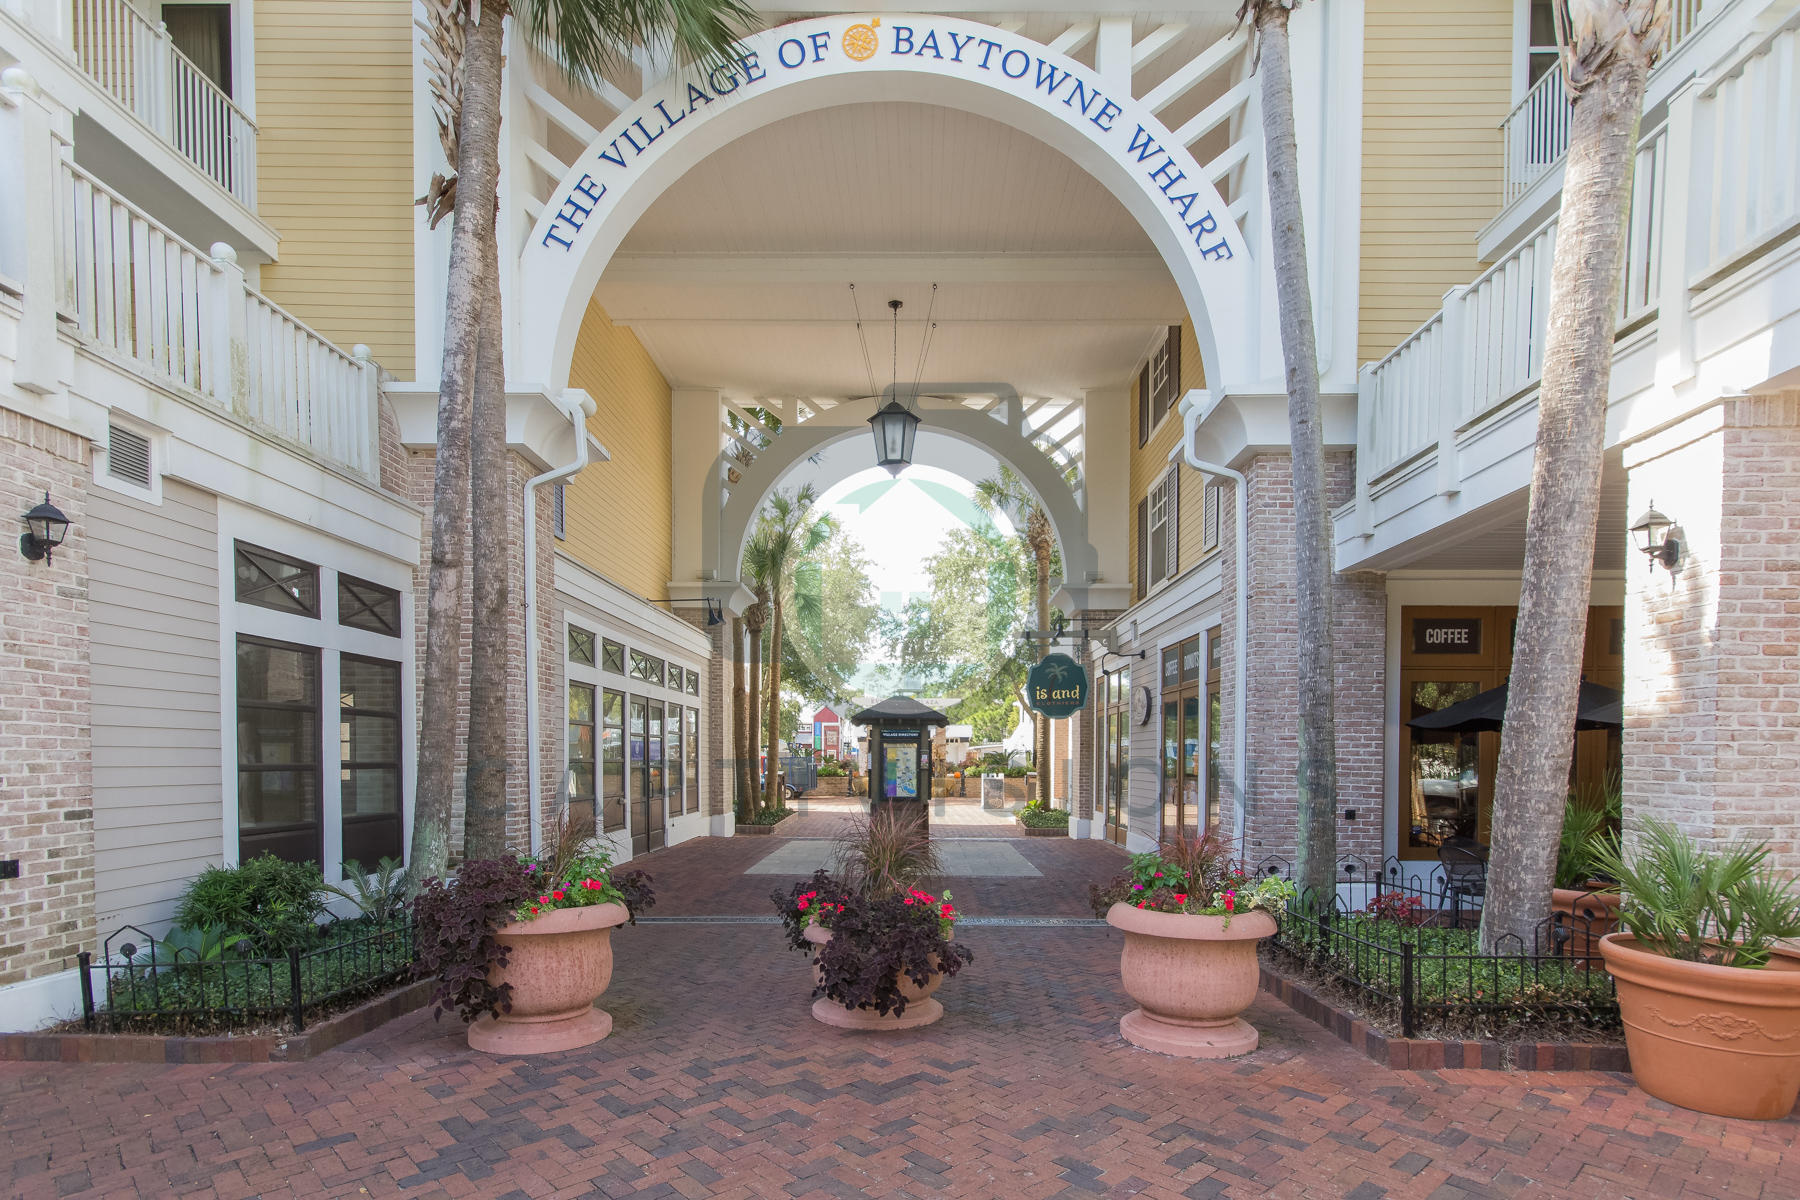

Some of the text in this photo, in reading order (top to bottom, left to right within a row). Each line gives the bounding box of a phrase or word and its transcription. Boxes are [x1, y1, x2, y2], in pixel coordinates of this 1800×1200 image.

[541, 26, 1233, 264] THE VILLAGE OF BAYTOWNE WHARF
[1426, 628, 1469, 643] COFFEE
